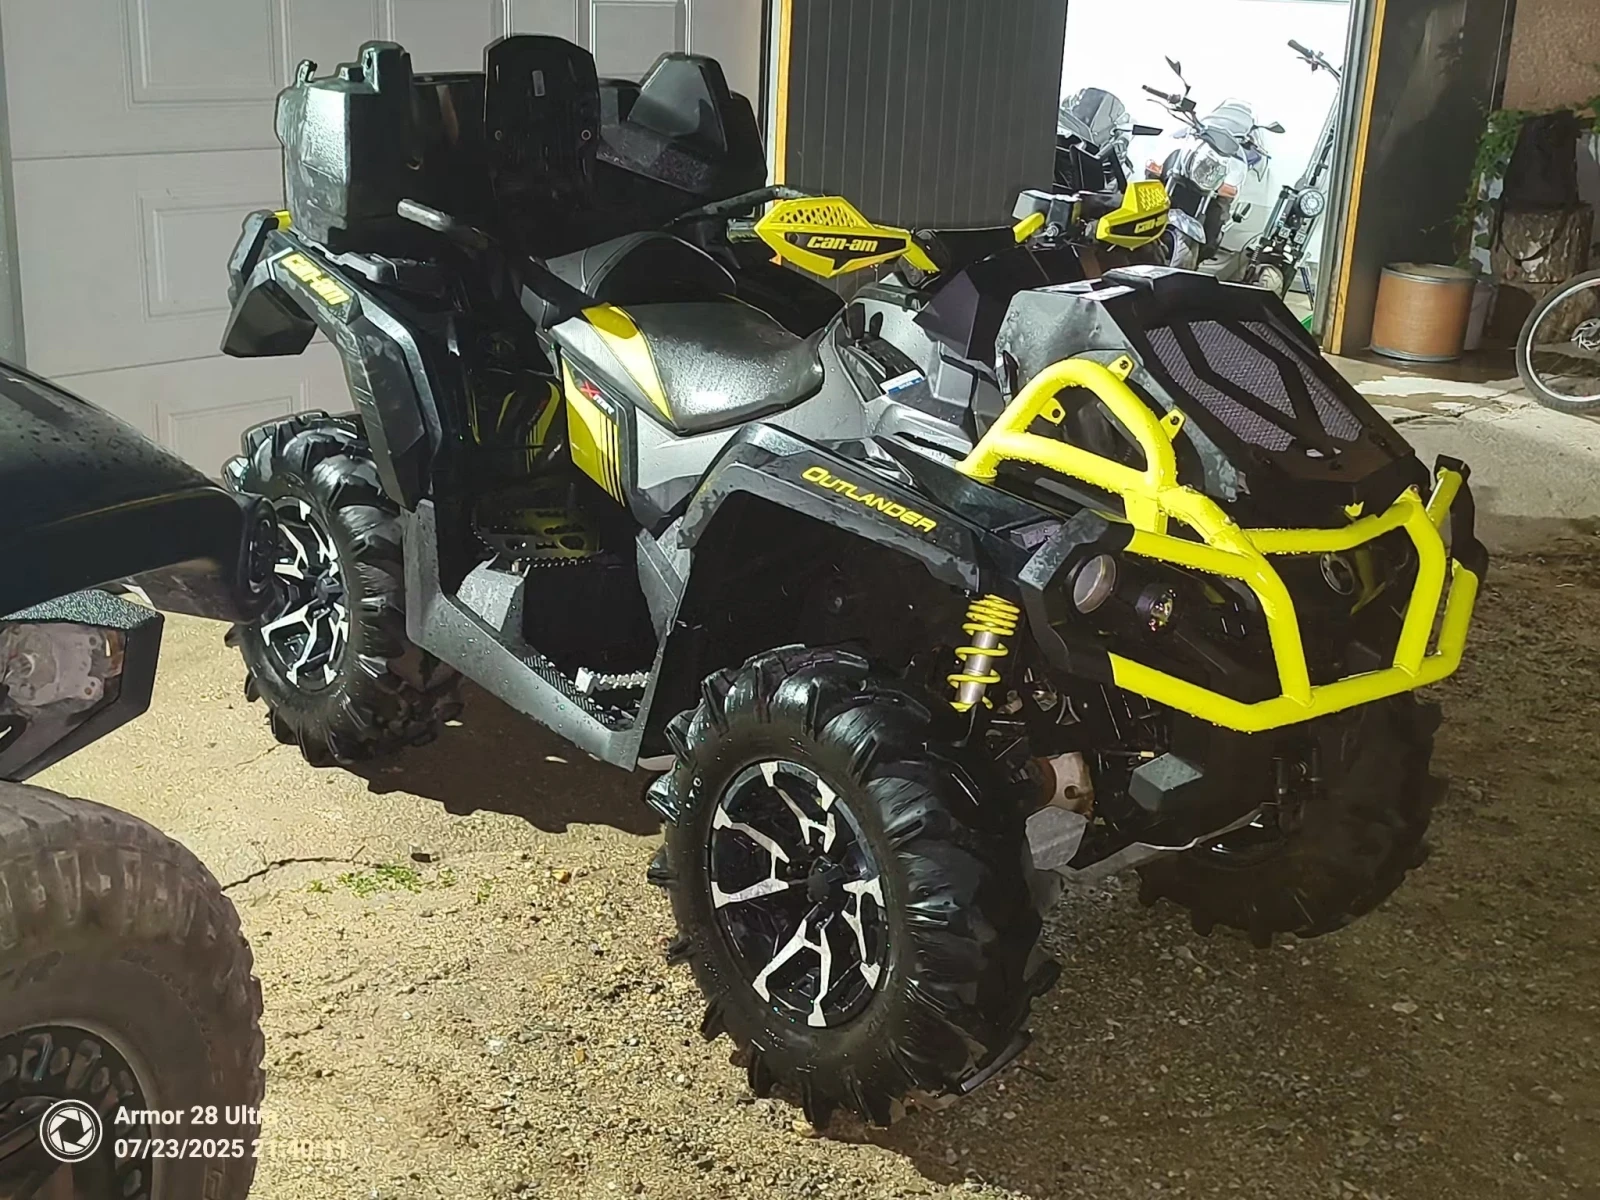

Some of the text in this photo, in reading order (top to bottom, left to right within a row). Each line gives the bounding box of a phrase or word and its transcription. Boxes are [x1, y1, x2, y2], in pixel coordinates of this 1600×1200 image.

[807, 236, 878, 252] can-am
[281, 253, 351, 305] can-am
[802, 466, 937, 532] OUTLANDER
